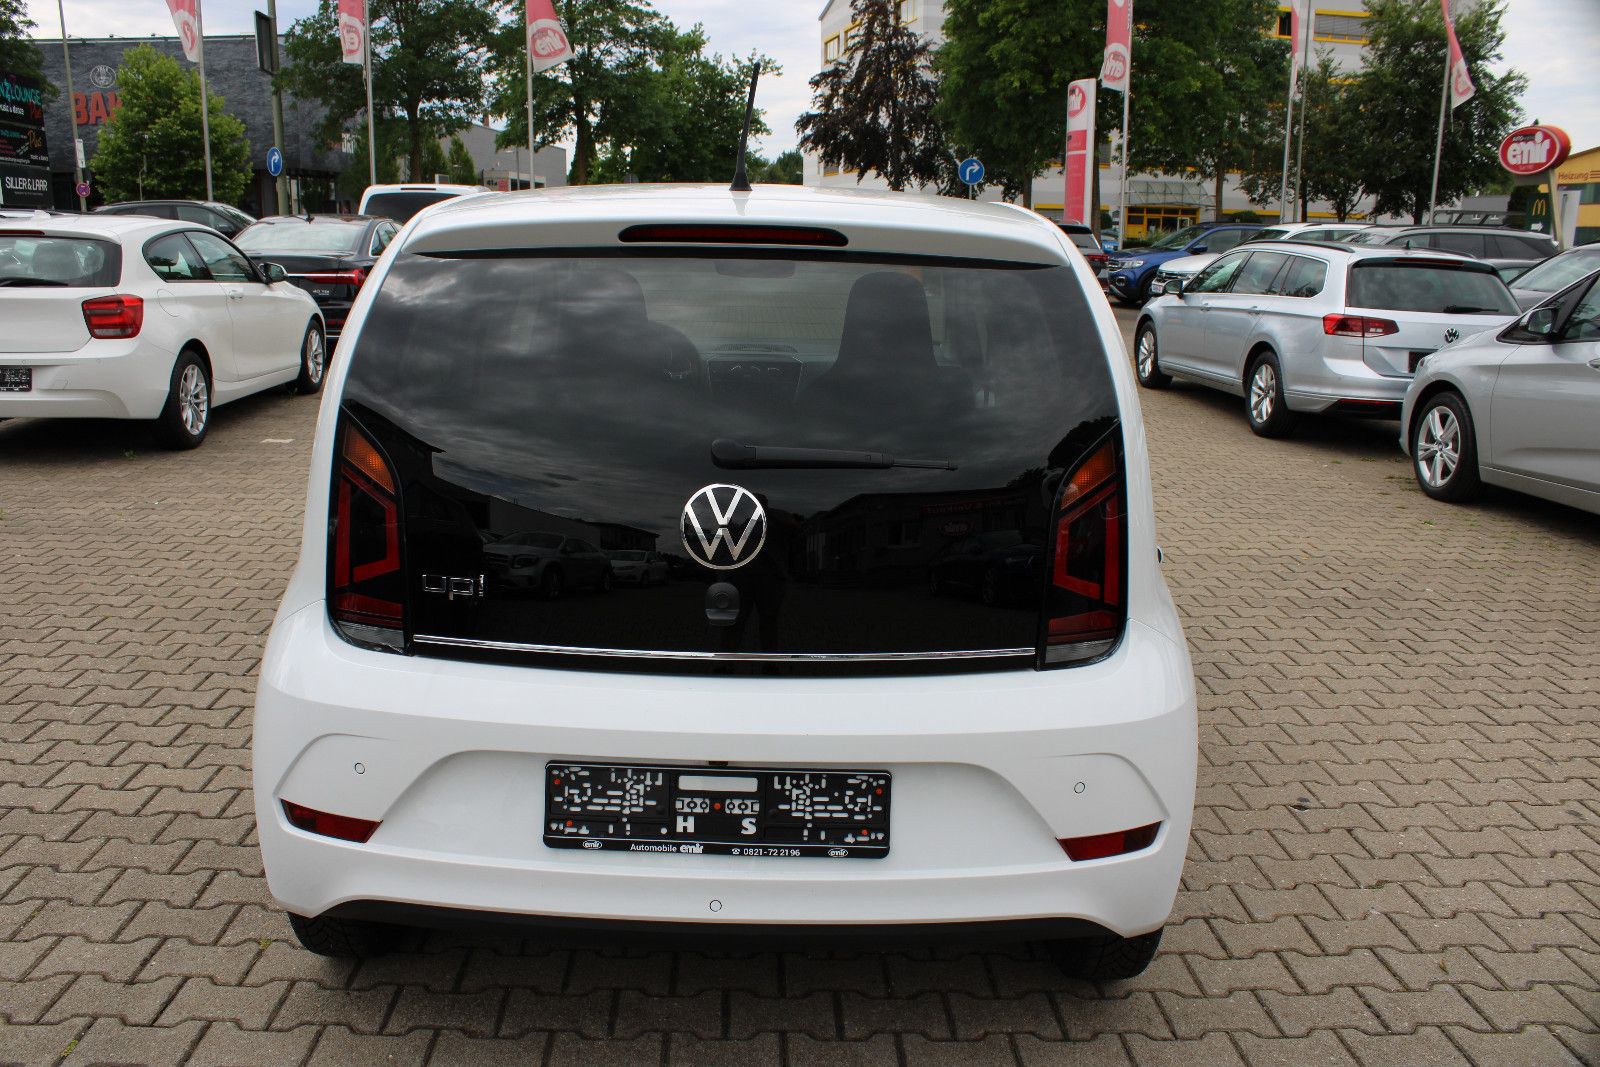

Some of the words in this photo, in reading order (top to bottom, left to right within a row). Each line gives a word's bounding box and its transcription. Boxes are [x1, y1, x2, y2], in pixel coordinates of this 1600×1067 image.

[1507, 131, 1551, 165] emir
[1559, 169, 1591, 181] Heizung
[676, 815, 695, 833] H
[740, 817, 757, 835] S
[584, 841, 602, 849] emir
[630, 843, 677, 853] Automobile
[679, 842, 704, 854] emir
[829, 848, 847, 857] emir
